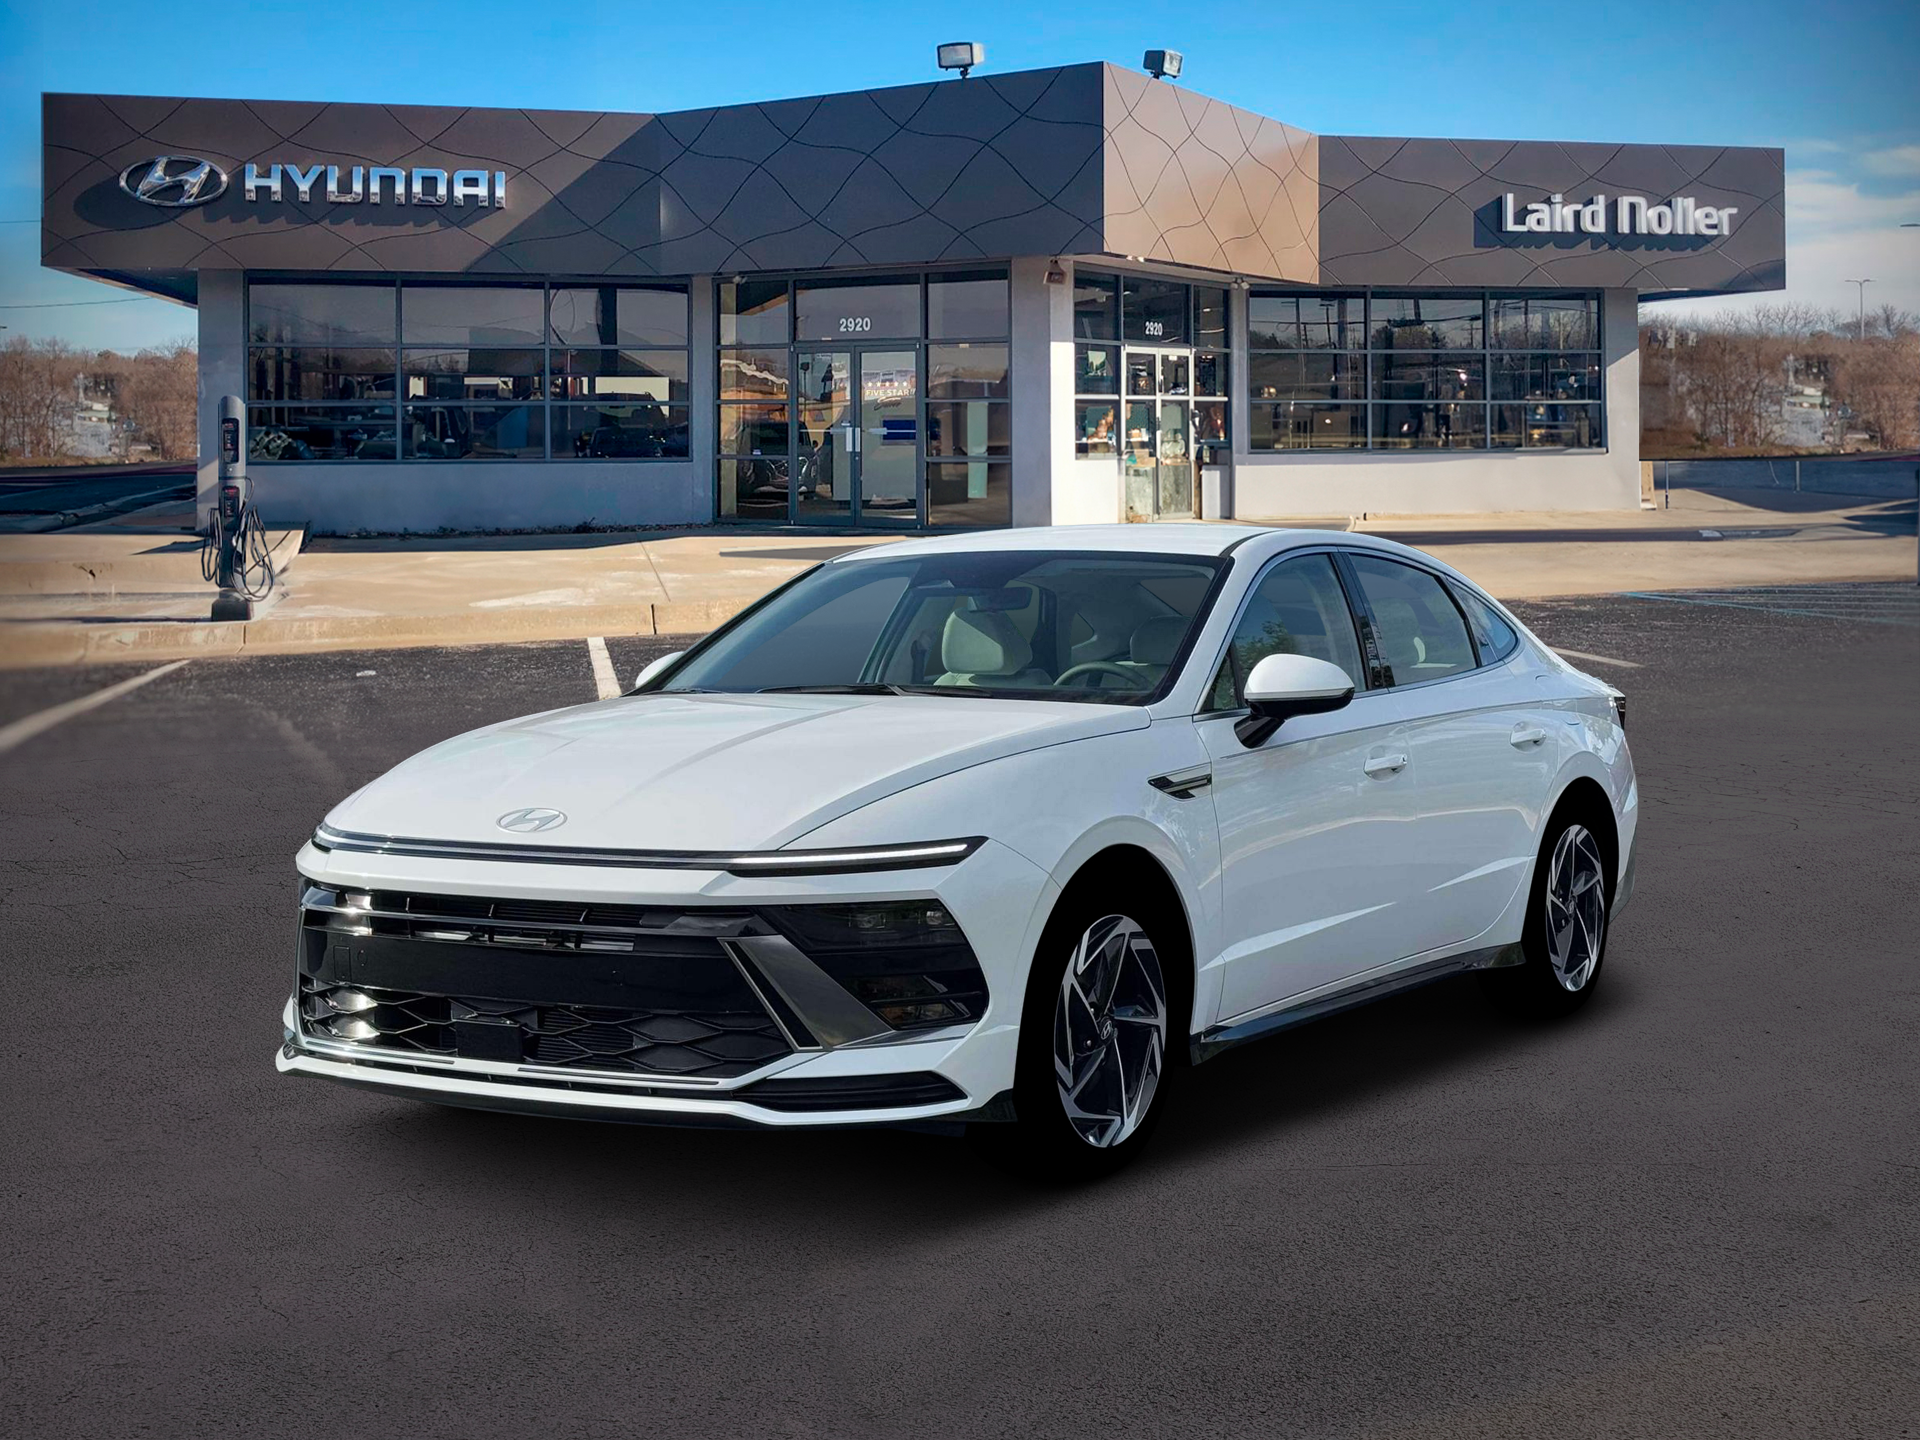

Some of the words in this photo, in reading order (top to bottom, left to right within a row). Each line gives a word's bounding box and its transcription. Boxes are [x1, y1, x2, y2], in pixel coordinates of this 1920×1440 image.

[245, 163, 507, 208] HYUNDAI
[1501, 193, 1606, 232] Laird
[1617, 196, 1738, 235] Noller
[839, 317, 871, 332] 2920
[1145, 320, 1163, 336] 2920
